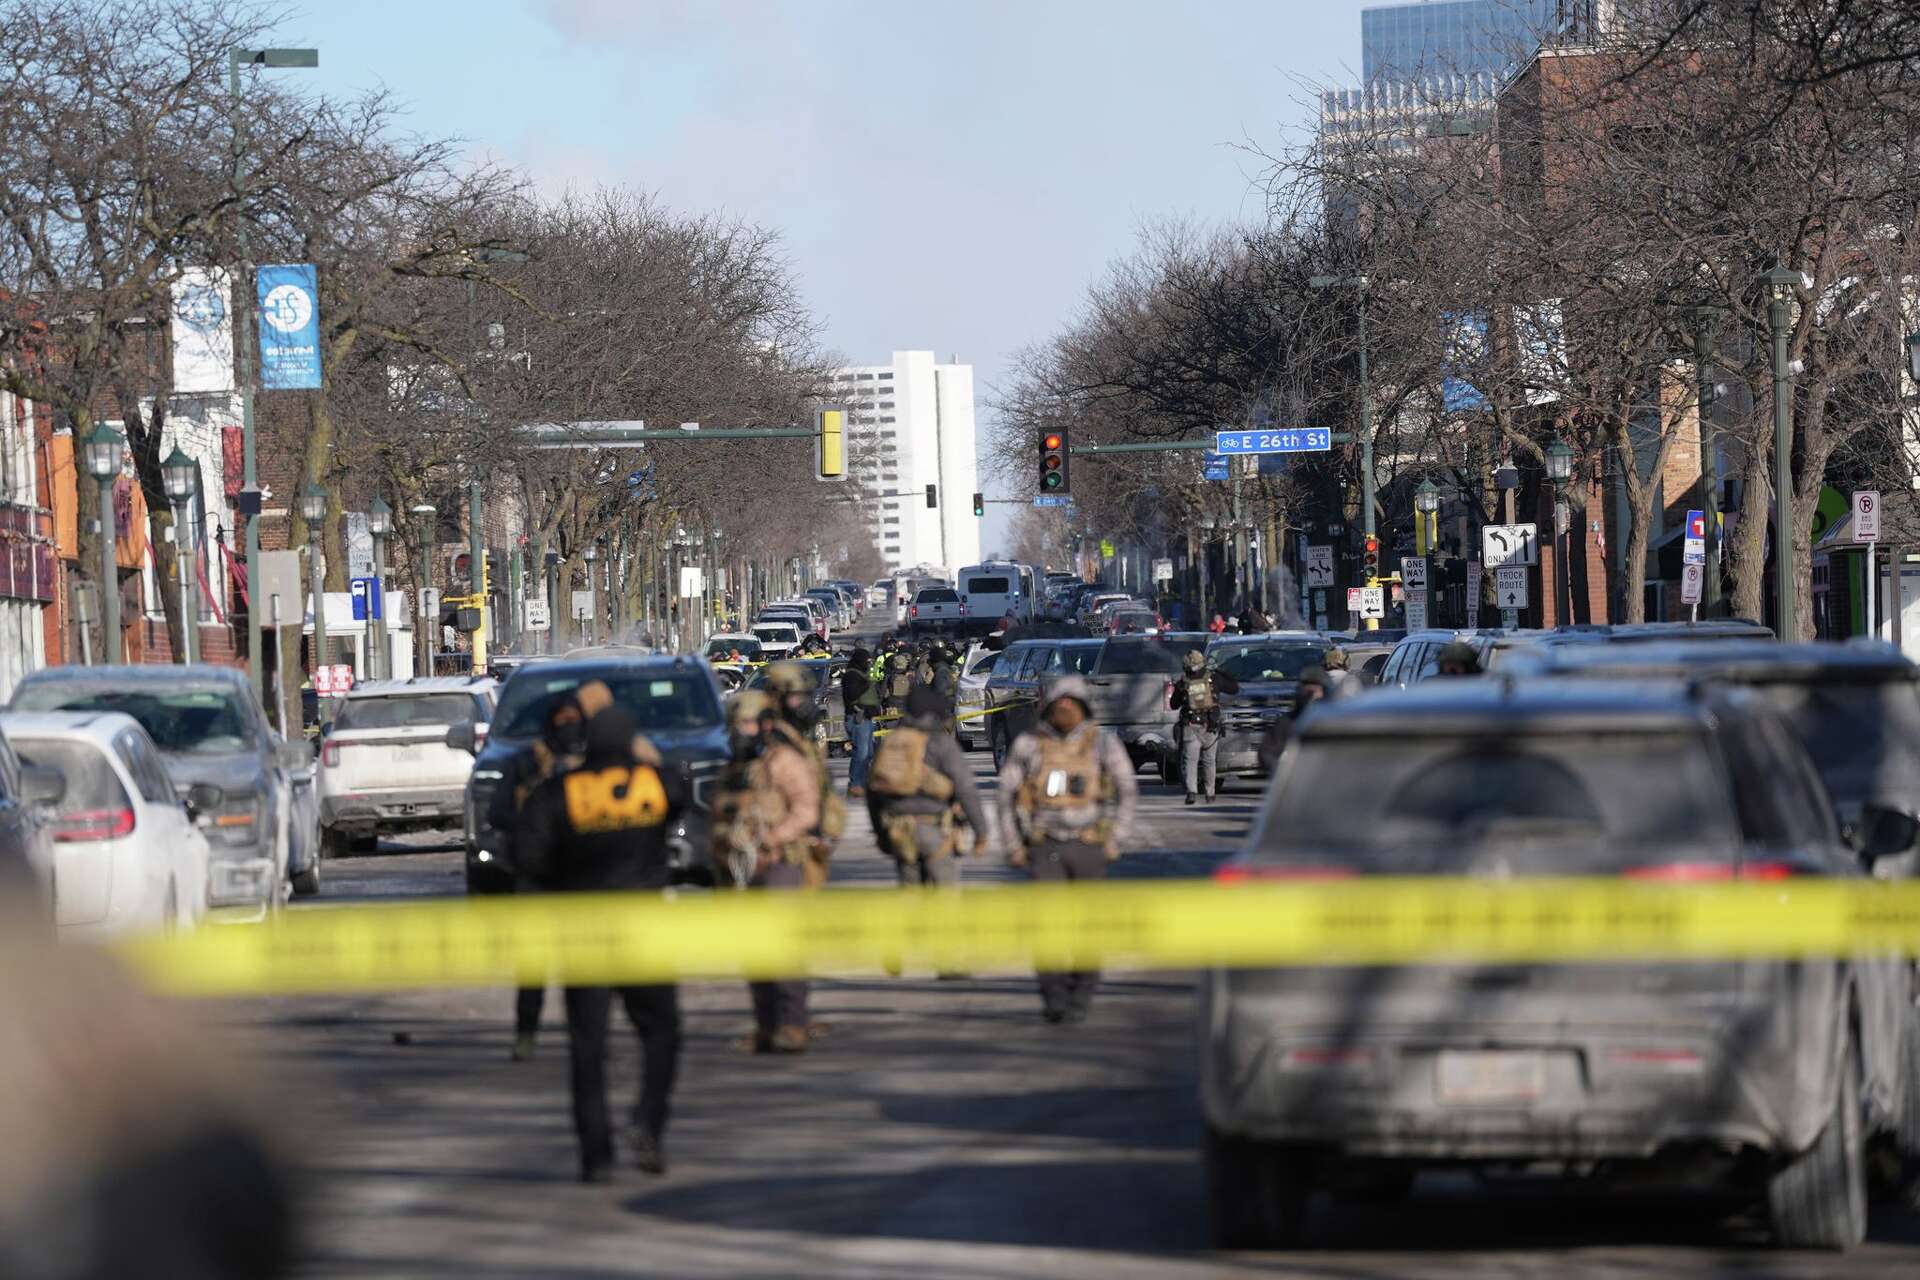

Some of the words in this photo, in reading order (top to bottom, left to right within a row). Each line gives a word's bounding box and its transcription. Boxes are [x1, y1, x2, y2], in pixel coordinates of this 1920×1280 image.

[1242, 436, 1252, 449] E
[1260, 434, 1300, 449] 26th
[1307, 432, 1326, 447] St
[1487, 555, 1508, 564] ONLY
[1406, 560, 1424, 568] ONE
[1406, 569, 1425, 577] WAY
[1499, 571, 1523, 579] TRUCK
[1499, 581, 1523, 589] ROUTE
